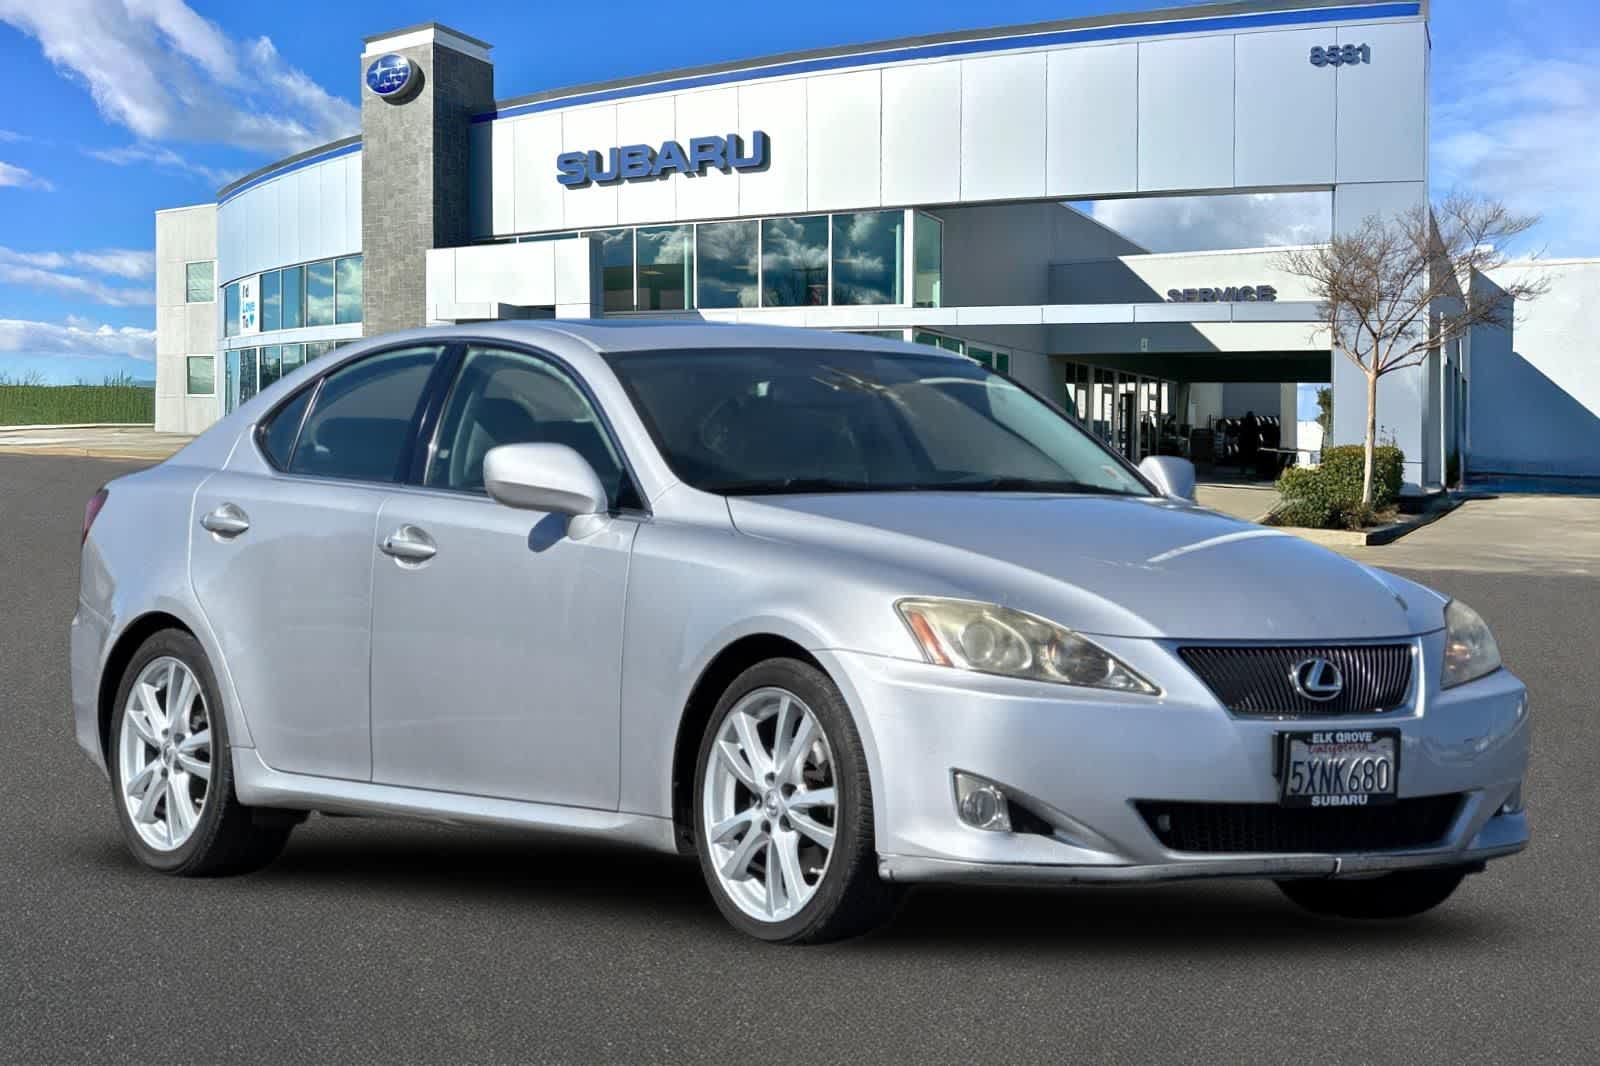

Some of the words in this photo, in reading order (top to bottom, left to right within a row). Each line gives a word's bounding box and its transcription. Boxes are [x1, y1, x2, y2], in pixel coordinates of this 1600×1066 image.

[556, 130, 771, 190] SUBARU
[1166, 284, 1278, 303] SERVICE
[1312, 732, 1334, 744] ELK
[1335, 731, 1373, 743] GROVE
[1290, 757, 1389, 794] 5XNK680
[1311, 795, 1368, 806] SUBARU
